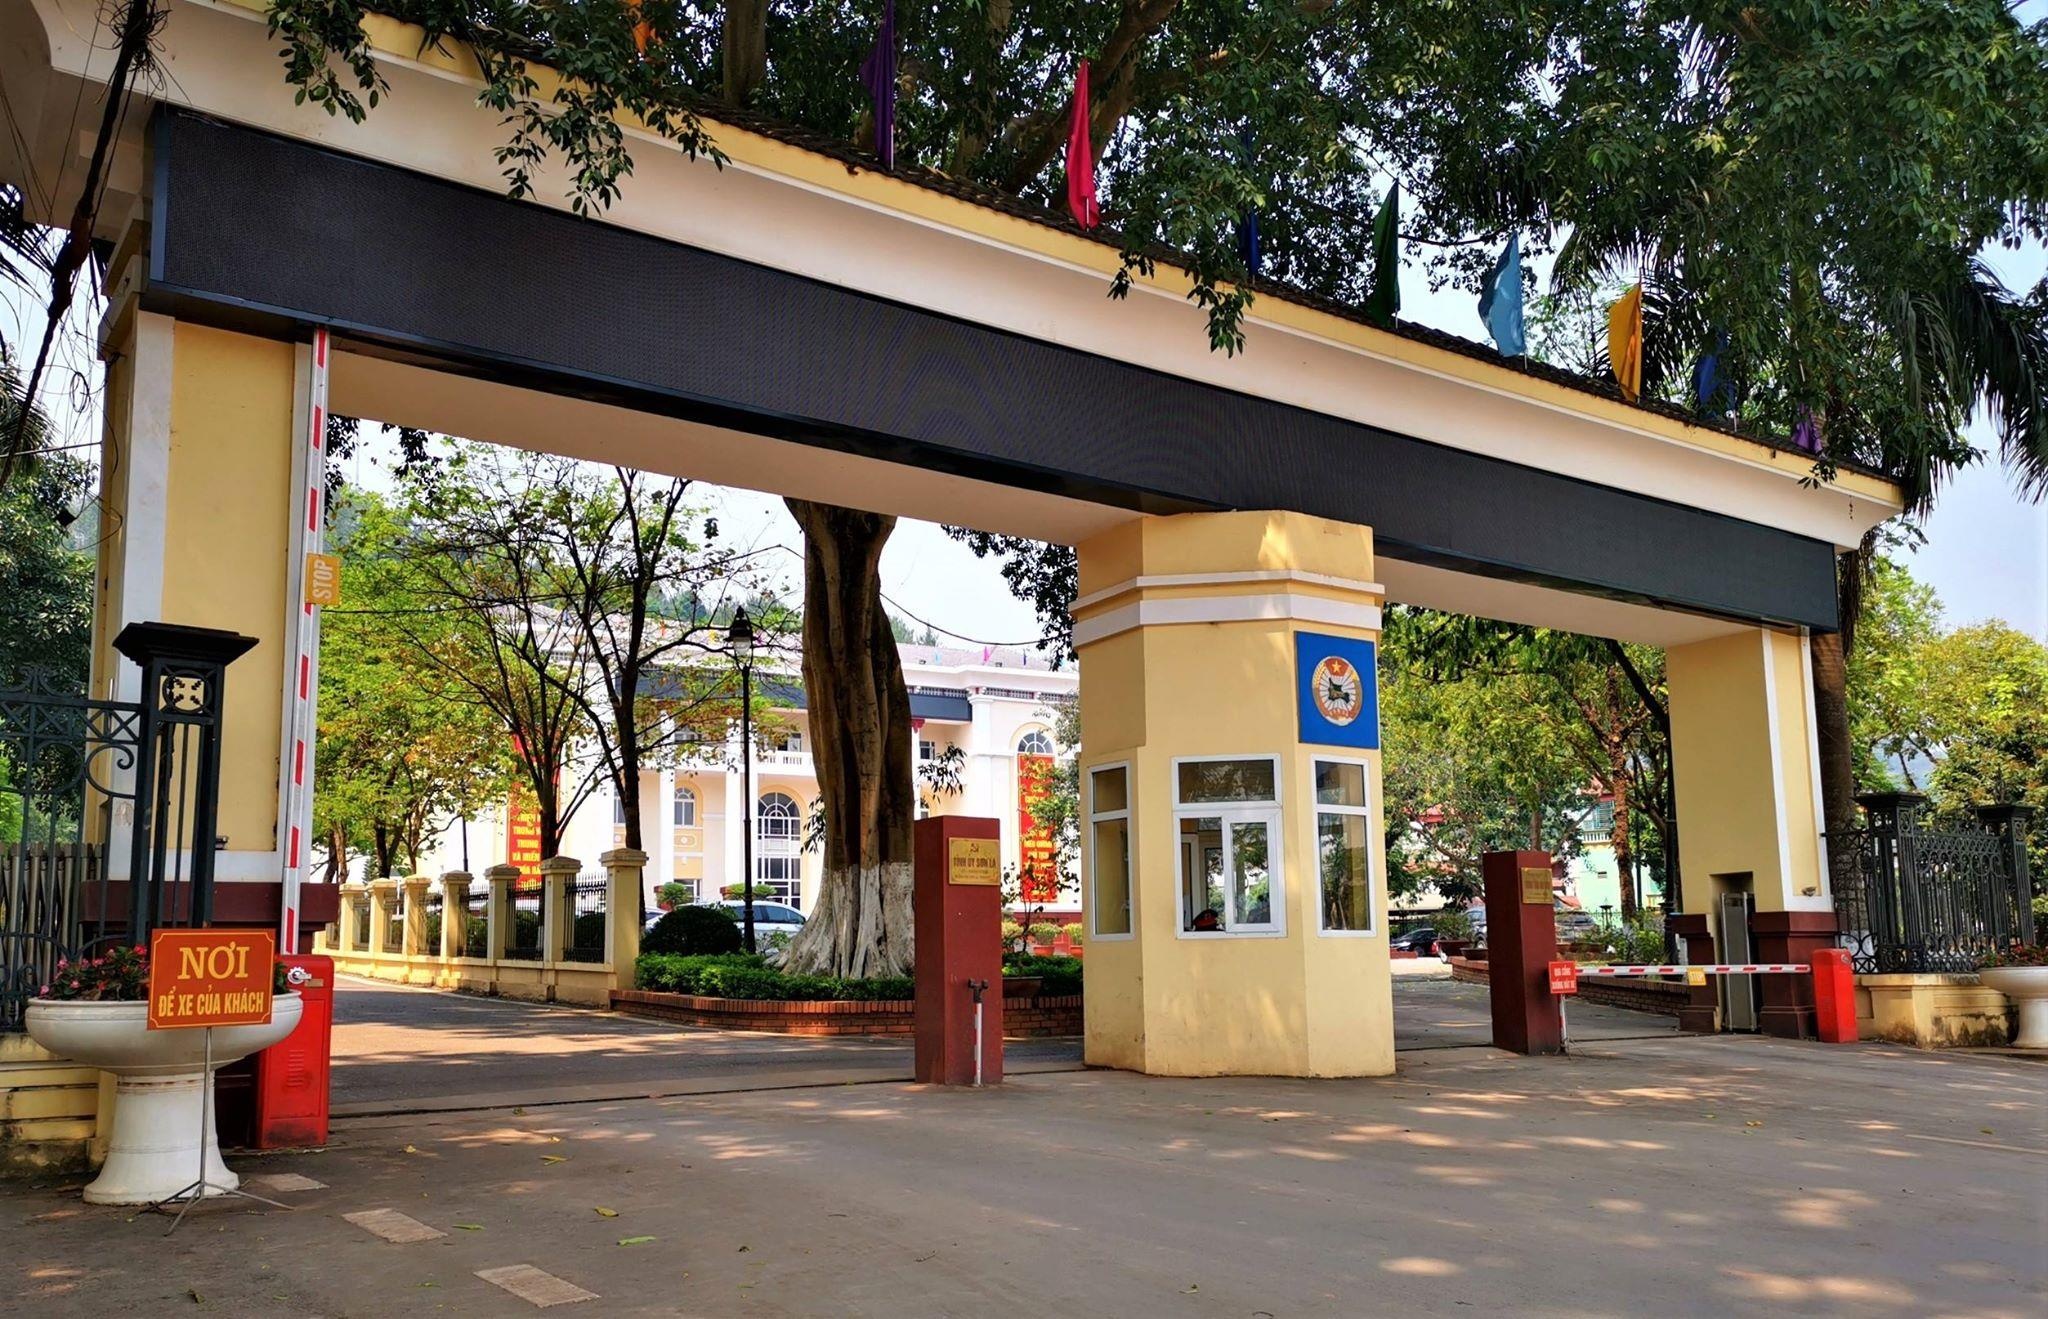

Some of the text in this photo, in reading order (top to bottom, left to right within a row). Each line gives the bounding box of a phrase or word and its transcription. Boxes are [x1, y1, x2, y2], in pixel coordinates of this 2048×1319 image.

[312, 559, 333, 599] STOP
[177, 941, 250, 979] NƠI
[158, 984, 264, 1017] ĐỂ XE CỦA KHÁCH
